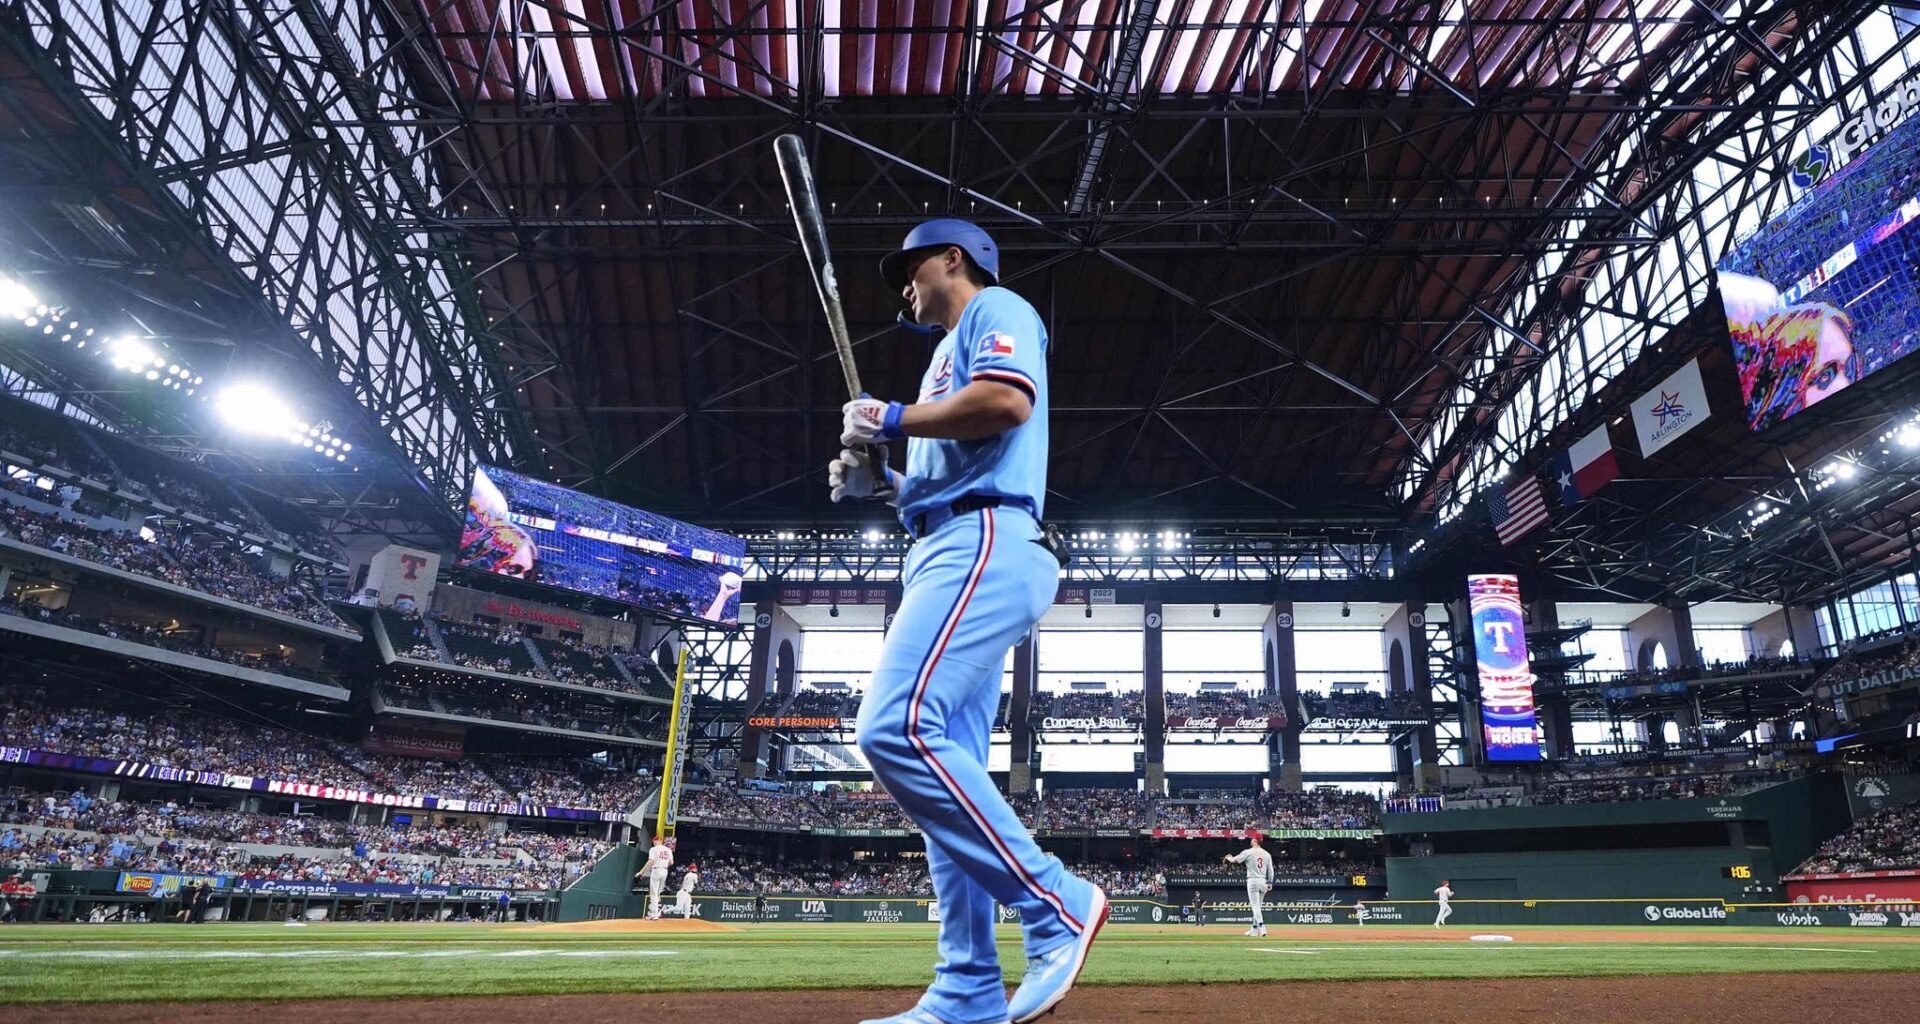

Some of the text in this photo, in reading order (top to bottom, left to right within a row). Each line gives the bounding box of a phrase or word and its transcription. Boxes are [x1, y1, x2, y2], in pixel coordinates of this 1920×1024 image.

[1651, 410, 1693, 442] ARLINGTON
[401, 553, 427, 580] T
[1093, 589, 1112, 597] 2023
[757, 615, 771, 626] 42
[1150, 616, 1157, 626] 7
[1279, 615, 1291, 625] 29
[1411, 615, 1422, 625] 10
[1484, 621, 1512, 653] T
[1832, 665, 1920, 695] UT DALLAS
[749, 717, 776, 727] CORE
[779, 717, 840, 727] PERSONNEL
[1099, 717, 1128, 728] Bank
[1184, 716, 1218, 729] Coca-Cola
[1235, 716, 1270, 729] Coca-Cola
[1319, 717, 1379, 727] CHOCTAW
[667, 753, 682, 822] CHIKIN
[268, 780, 319, 797] MAKE
[324, 787, 368, 802] SOME
[372, 793, 423, 808] NOISE
[1280, 830, 1371, 838] LUXOR STAFFING
[659, 850, 669, 860] 45
[1257, 857, 1263, 869] 3
[1731, 866, 1751, 878] 1:06
[802, 900, 827, 913] UTA
[1298, 914, 1314, 923] AIR
[1663, 907, 1727, 919] Globe Life
[1777, 913, 1821, 925] Kubota
